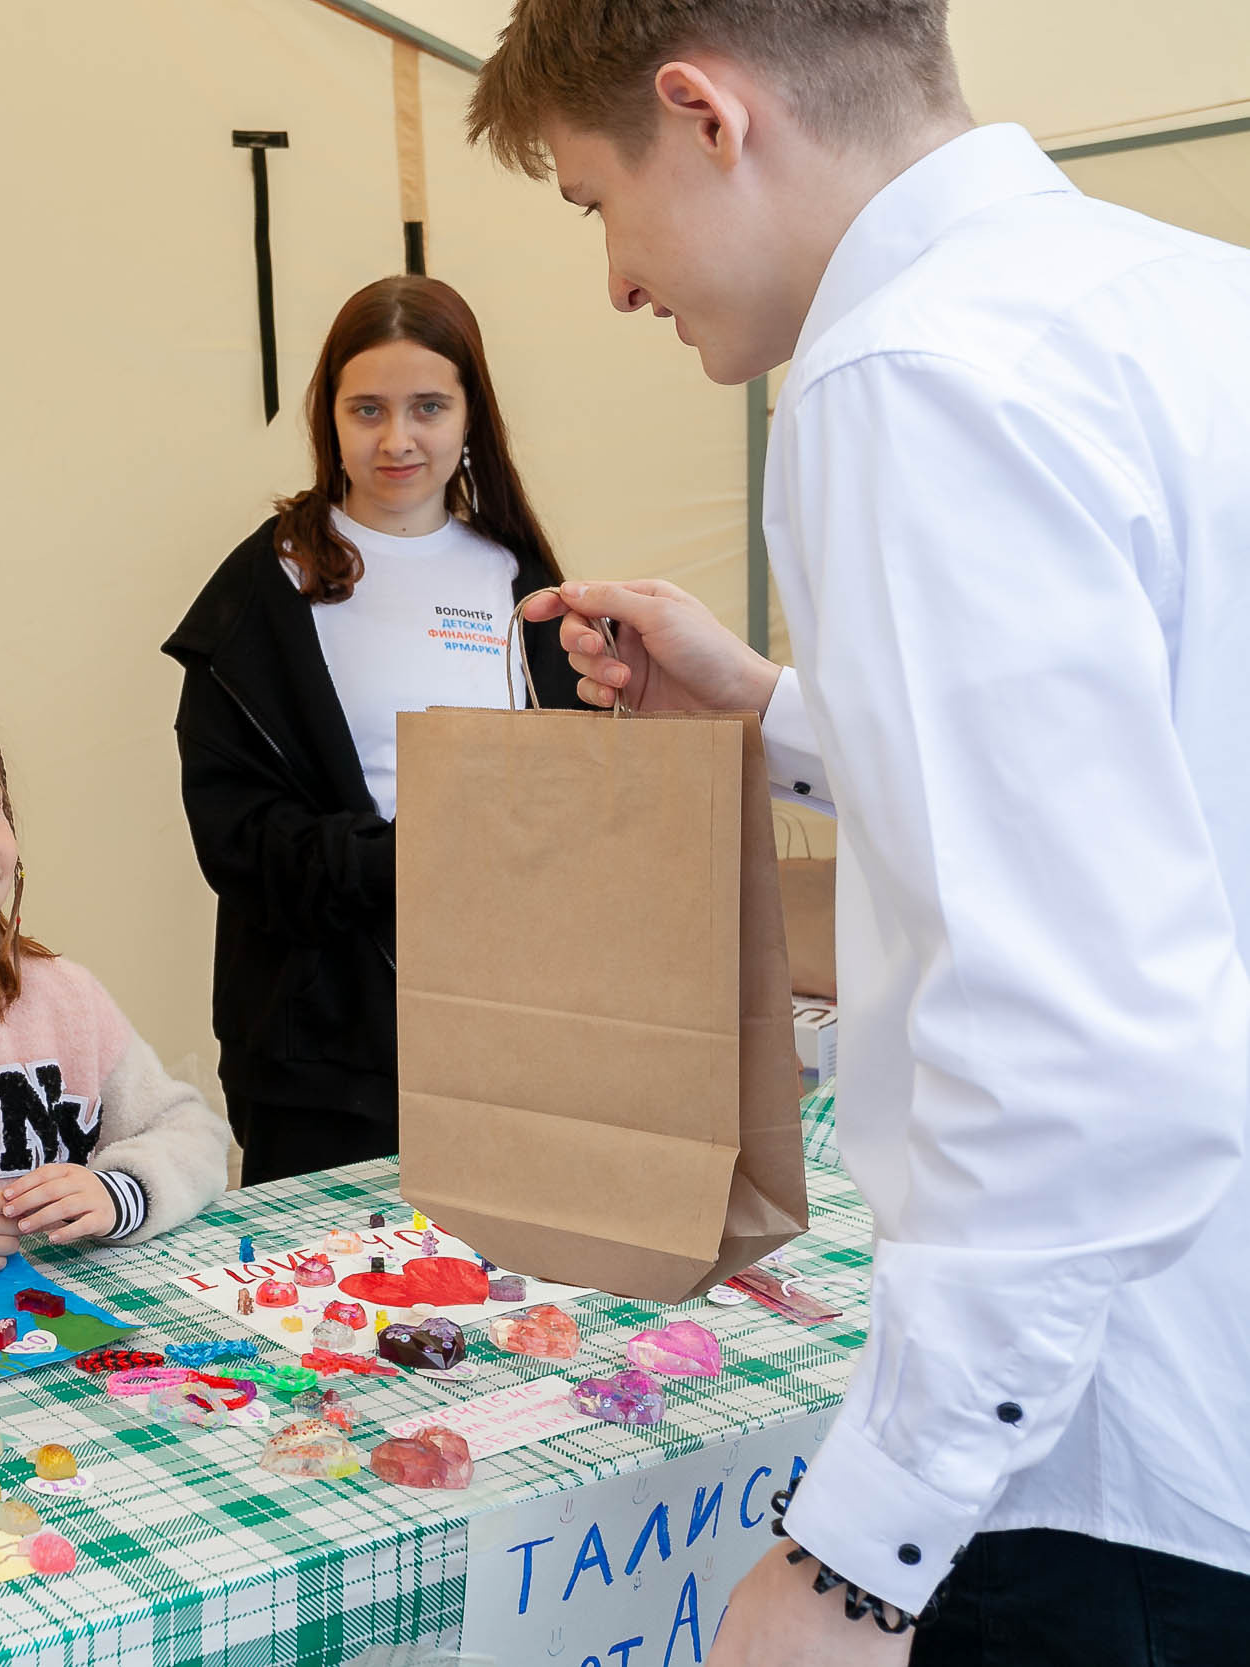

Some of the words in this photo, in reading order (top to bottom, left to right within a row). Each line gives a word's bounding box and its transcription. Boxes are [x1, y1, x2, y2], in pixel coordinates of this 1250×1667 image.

[435, 606, 493, 621] ВОЛОНТЁР
[442, 618, 493, 633] ДЕТСКОЙ
[428, 629, 508, 647] ФИНАНСОВОЙ
[444, 641, 501, 656] ЯРМАРКИ
[178, 1273, 219, 1292] I
